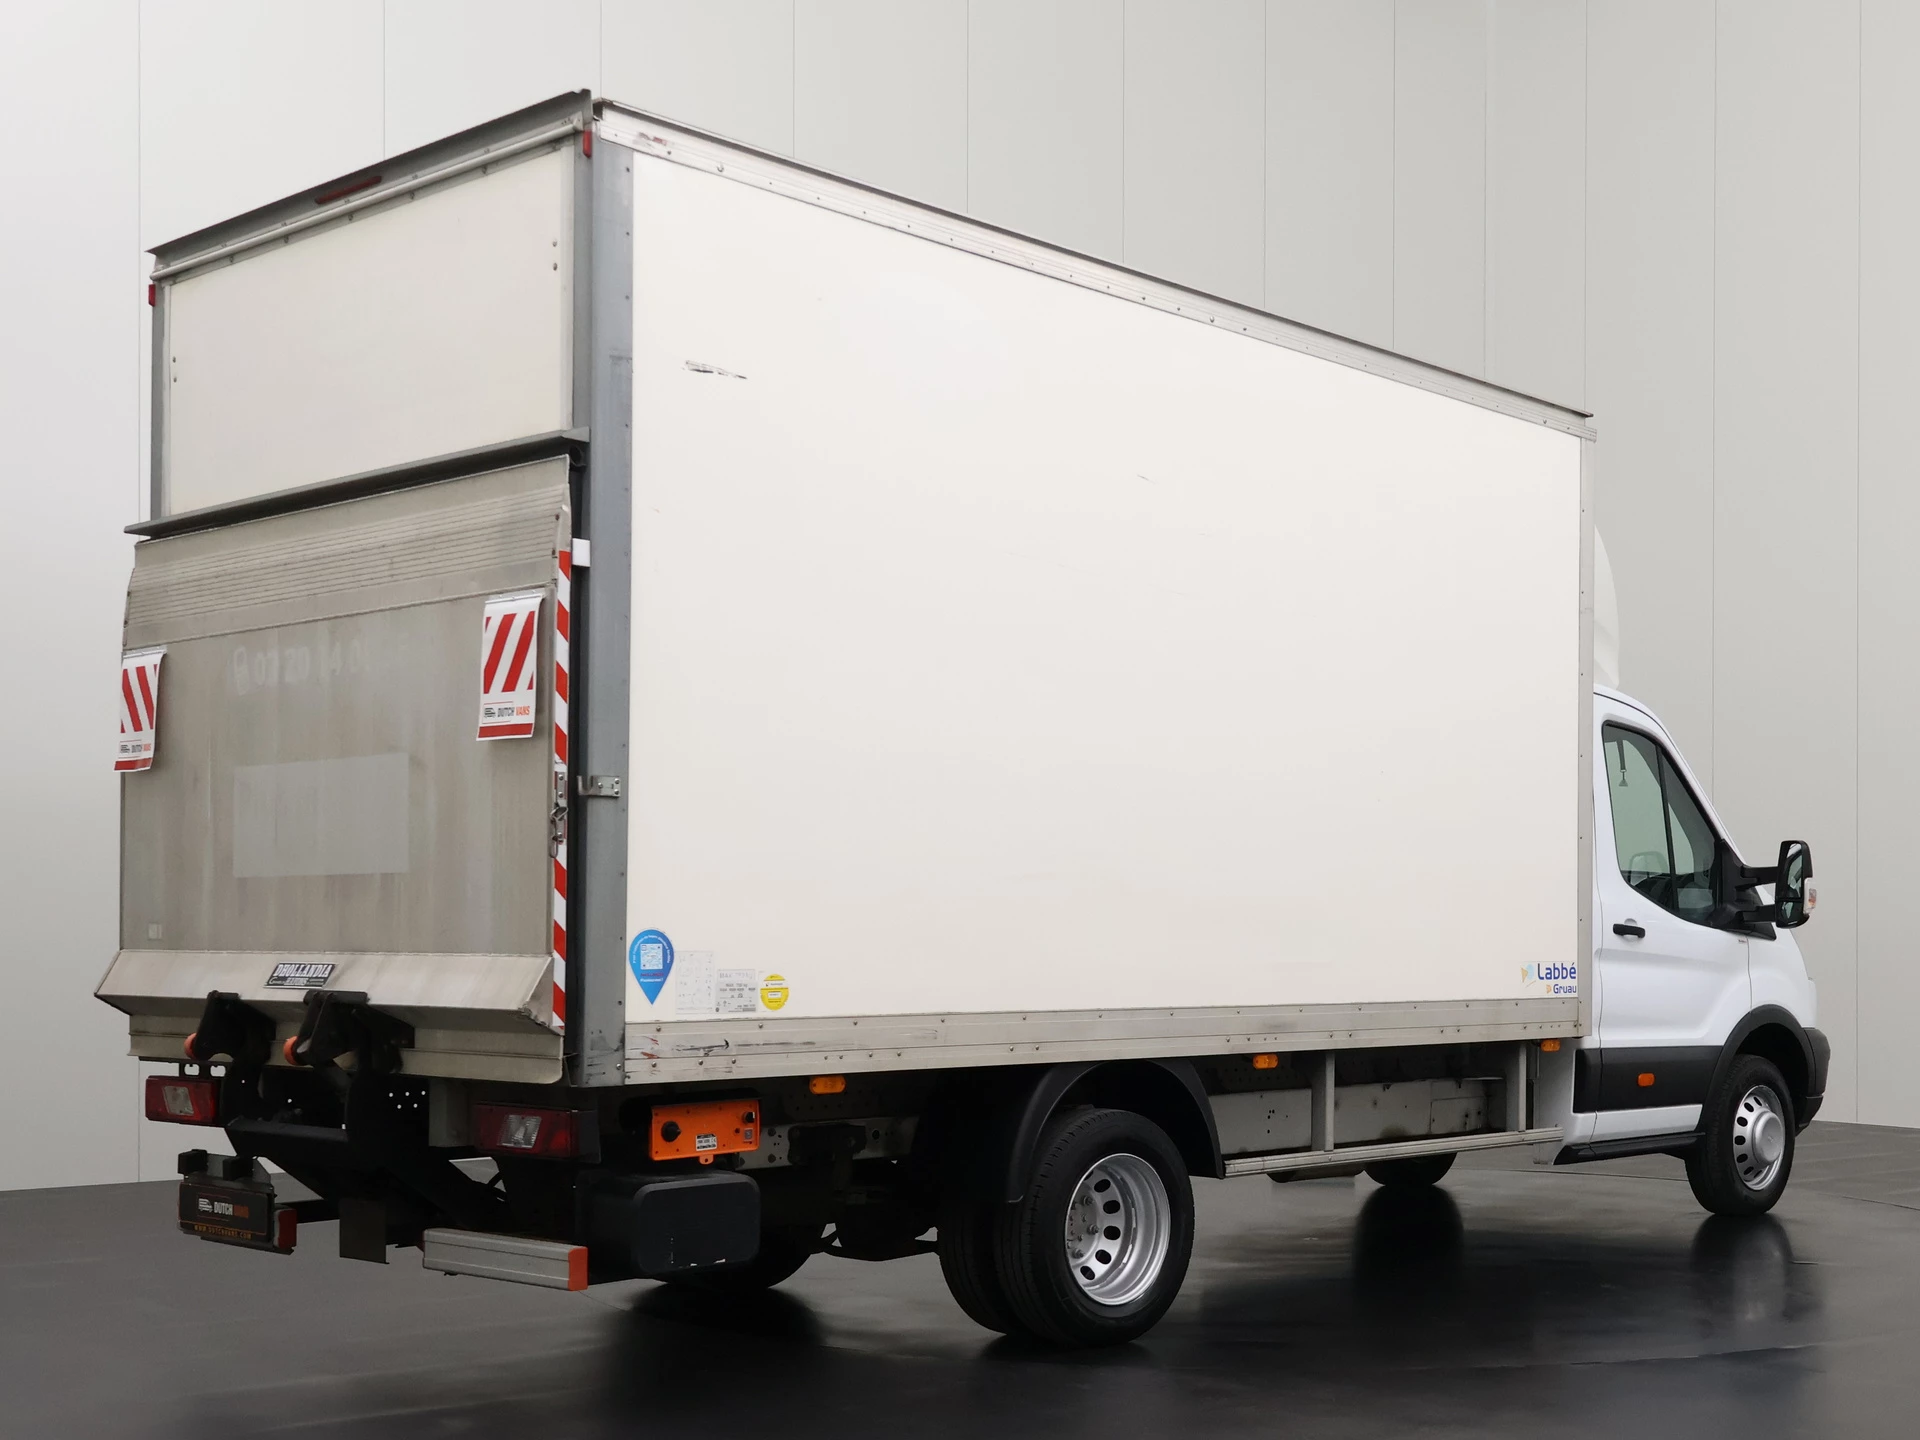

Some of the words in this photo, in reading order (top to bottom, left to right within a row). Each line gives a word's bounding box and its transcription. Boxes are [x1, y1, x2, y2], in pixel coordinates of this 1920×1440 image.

[272, 964, 333, 978] DHOLLANDIA
[1537, 962, 1577, 980] Labbé
[1553, 984, 1577, 994] Gruau
[213, 1201, 234, 1216] DUTCH
